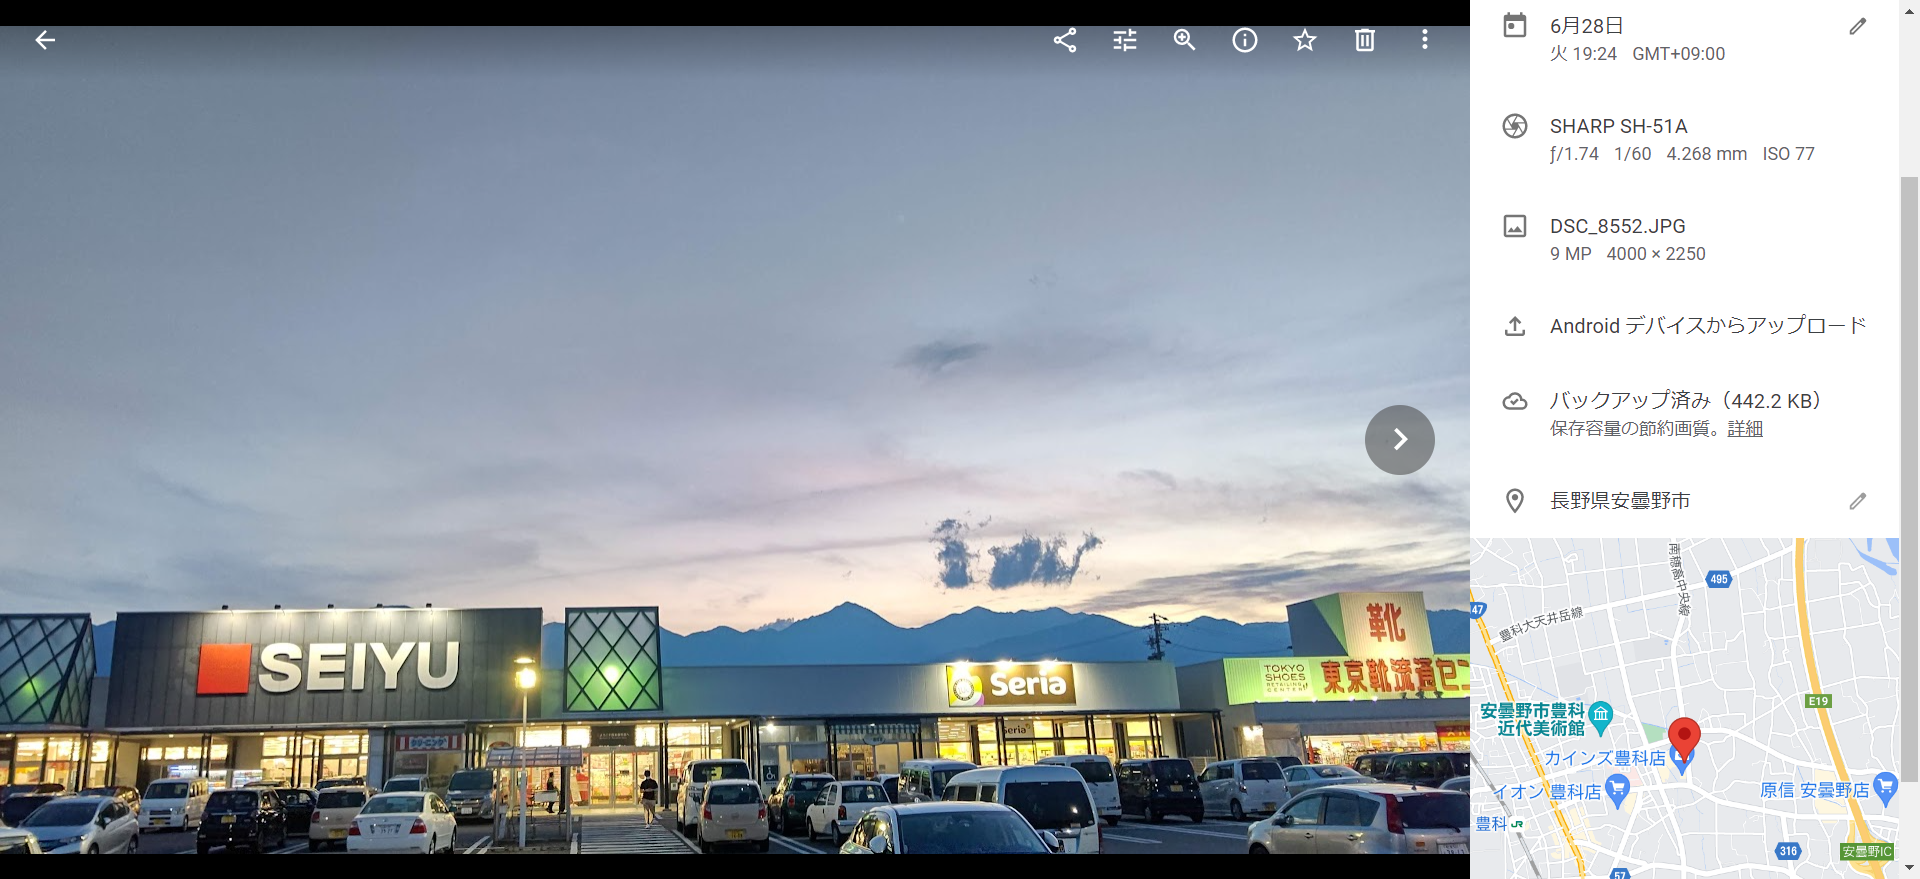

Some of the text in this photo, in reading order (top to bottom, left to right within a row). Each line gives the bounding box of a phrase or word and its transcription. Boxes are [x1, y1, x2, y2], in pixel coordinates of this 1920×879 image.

[1550, 17, 1623, 35] 6月28日
[1550, 45, 1726, 62] 火 19:24 GMT+09:00
[1550, 118, 1689, 134] SHARP SH-51A
[1614, 146, 1652, 162] 1/60
[1666, 146, 1712, 161] 4.268
[1716, 149, 1748, 161] mm
[1763, 146, 1791, 161] ISO
[1795, 146, 1816, 161] 77
[1550, 218, 1686, 235] DSC_8552.JPG
[1550, 246, 1560, 261] 9
[1565, 246, 1592, 261] MP
[1606, 246, 1647, 261] 4000
[1665, 246, 1706, 261] 2250
[1550, 314, 1866, 335] Android デバイスからアップロード
[1550, 491, 1691, 510] 長野県安曇野市
[1710, 573, 1728, 585] 495
[1470, 604, 1484, 615] 47
[1366, 602, 1406, 642] 靴
[258, 641, 459, 693] SEIYU
[1263, 664, 1305, 672] TOKYO
[990, 670, 1067, 696] Seria
[1265, 673, 1306, 682] SHOES
[1809, 696, 1828, 706] E19
[1480, 702, 1585, 719] 安曇野市豊科
[1497, 720, 1585, 737] 近代美術館
[1545, 750, 1666, 767] カインズ豊科店
[1493, 783, 1602, 800] イオン 豊科店
[1760, 781, 1870, 799] 原信 安曇野店
[1475, 816, 1508, 832] 豊科
[1780, 846, 1797, 856] 316
[1842, 845, 1892, 858] 安曇野IC
